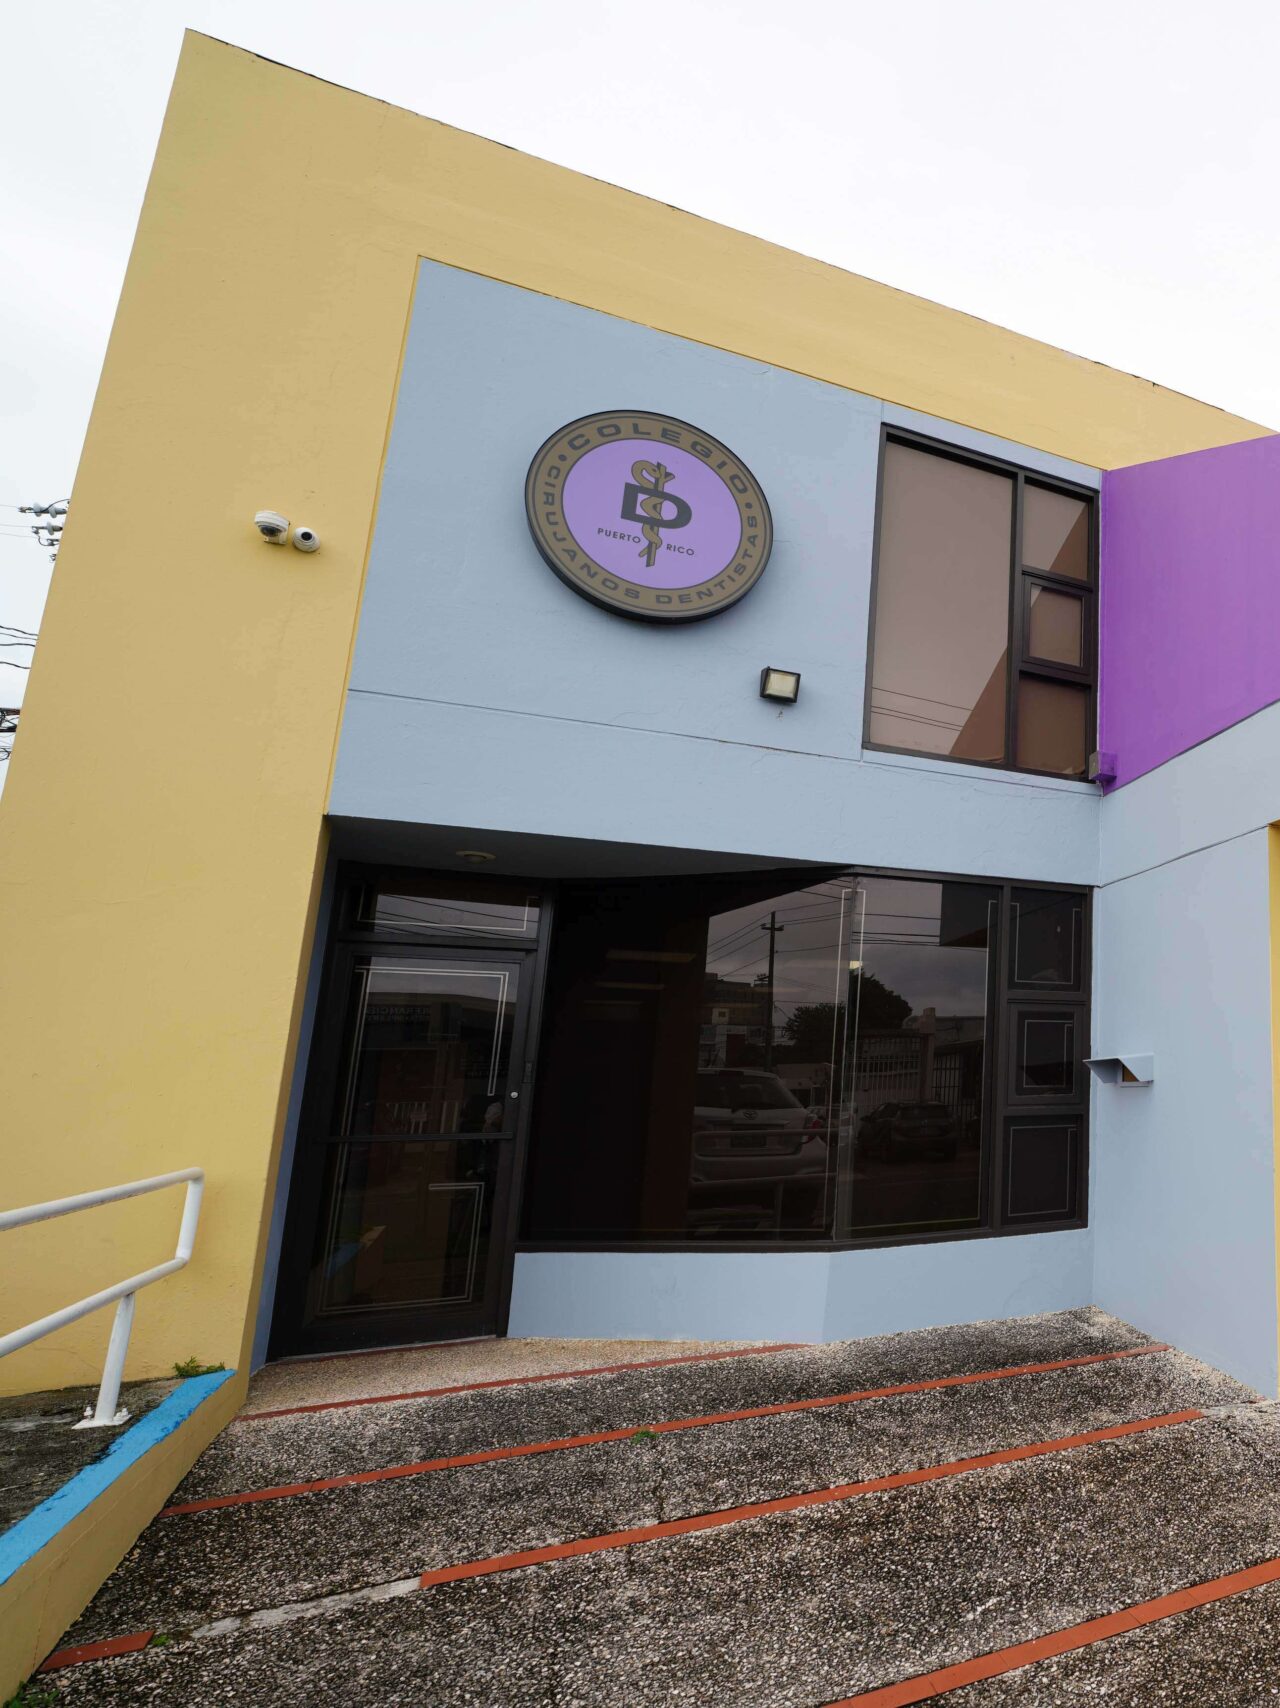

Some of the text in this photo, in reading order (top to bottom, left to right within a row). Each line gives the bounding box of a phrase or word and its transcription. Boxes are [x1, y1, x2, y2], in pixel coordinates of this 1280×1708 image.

[567, 422, 748, 494] COLEGIO
[543, 465, 758, 604] CIRUJANOS DENTISTAS
[597, 527, 695, 556] PUERTO RICO
